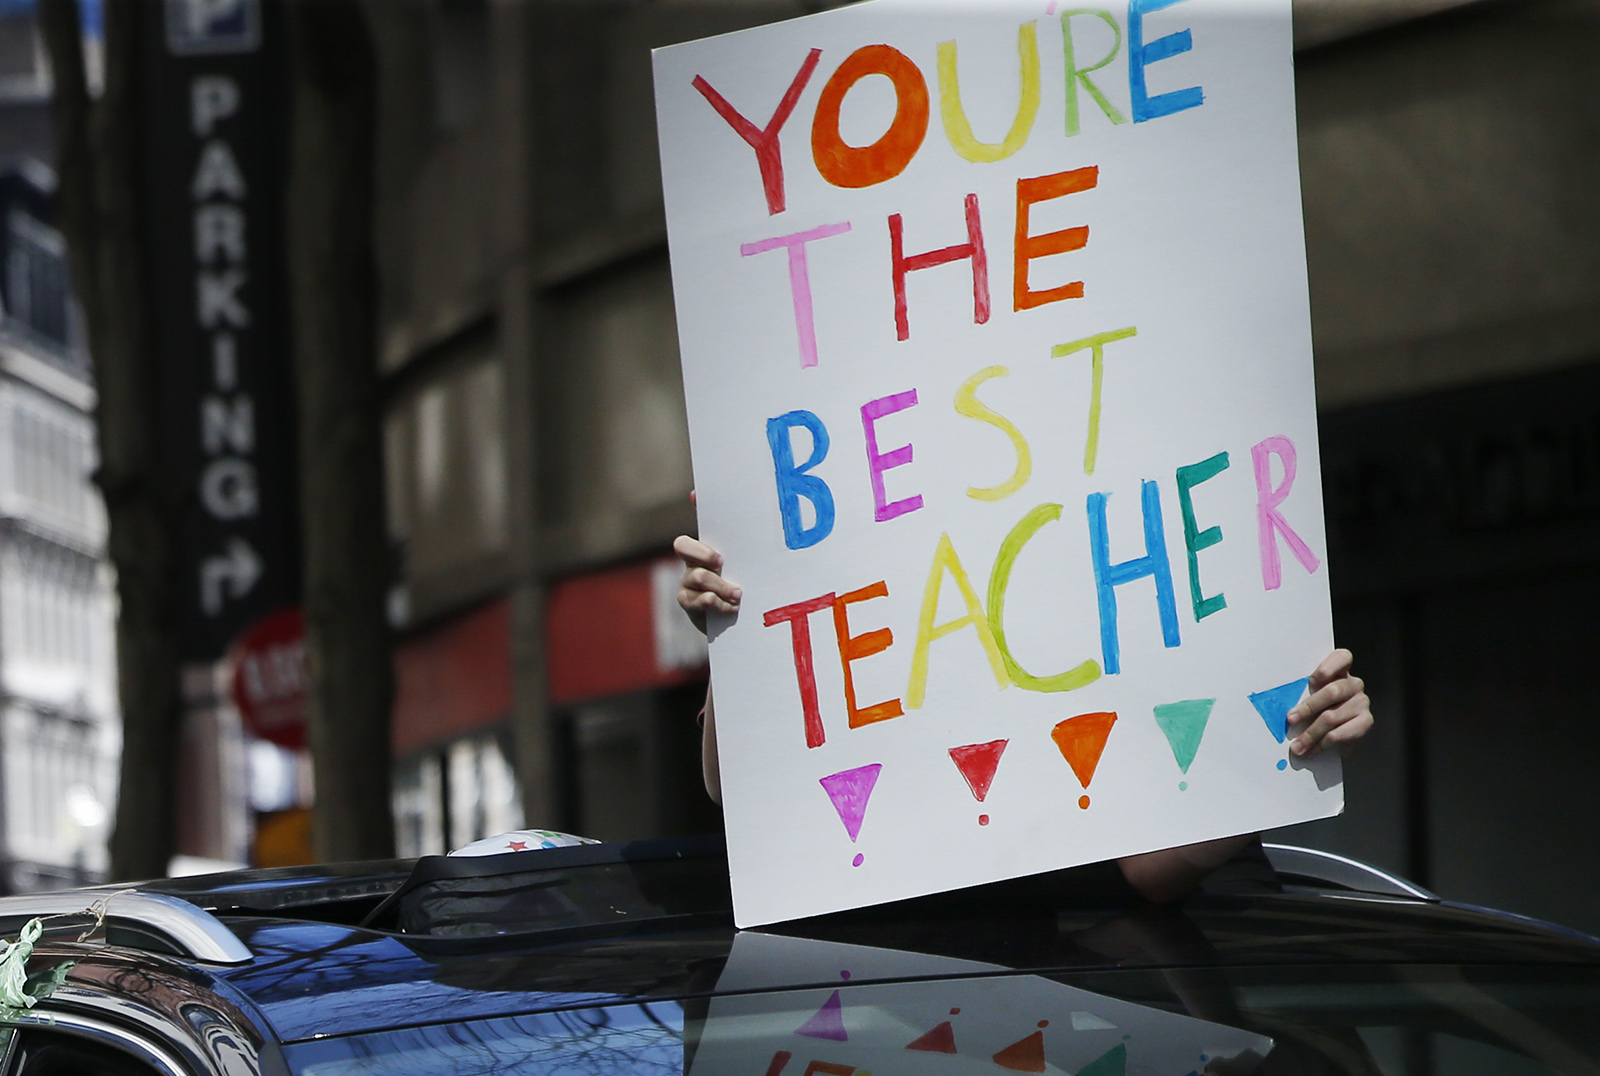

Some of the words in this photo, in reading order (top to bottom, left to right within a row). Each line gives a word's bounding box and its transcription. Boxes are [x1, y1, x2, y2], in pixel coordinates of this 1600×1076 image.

[190, 75, 259, 520] PARKING
[740, 165, 1100, 368] THE
[766, 326, 1138, 551] BEST
[763, 434, 1320, 748] TEACHER
